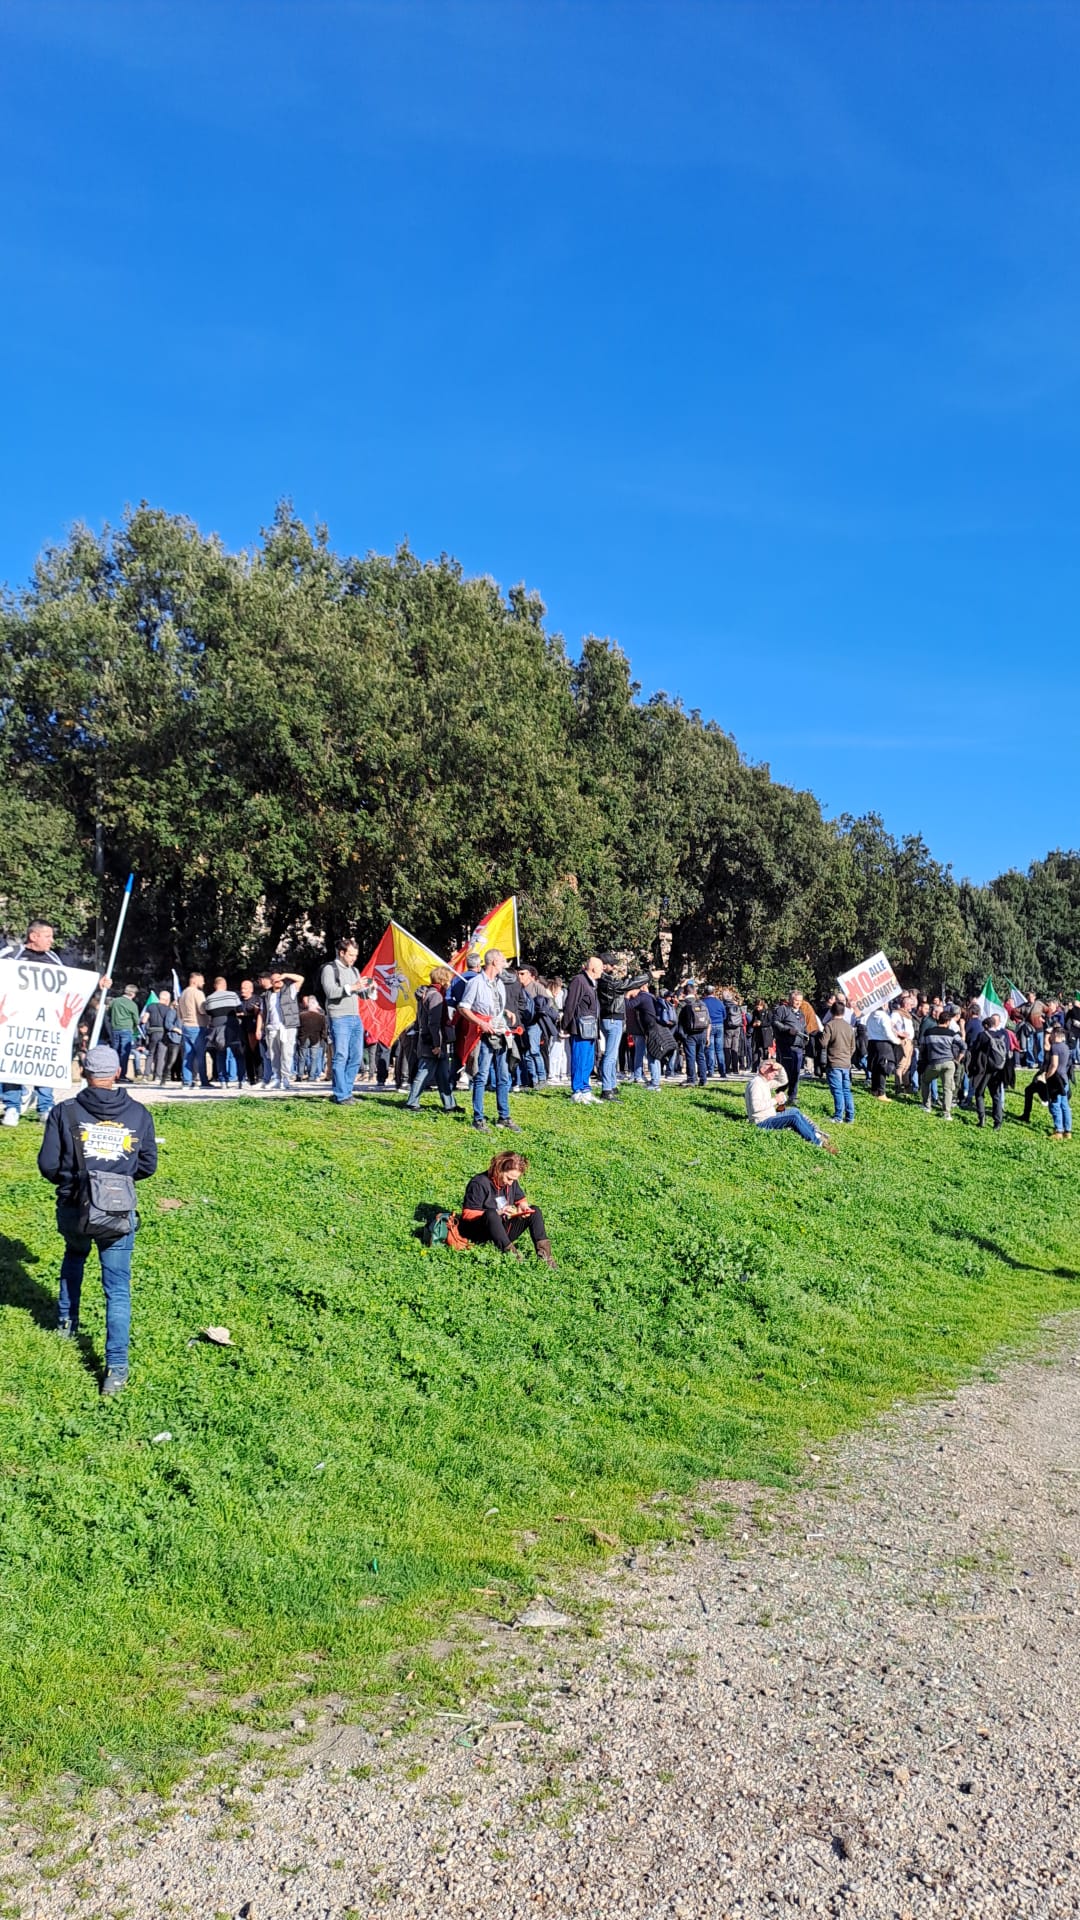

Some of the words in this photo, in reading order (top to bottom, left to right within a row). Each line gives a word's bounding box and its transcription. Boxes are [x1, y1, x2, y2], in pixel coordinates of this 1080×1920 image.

[869, 960, 887, 978] ALLE
[17, 965, 68, 994] STOP
[844, 970, 875, 1002] NO
[856, 980, 896, 1011] COLTIVATE
[35, 1007, 46, 1022] A
[6, 1025, 49, 1043] TUTTE
[50, 1031, 61, 1045] LE
[4, 1042, 59, 1062] GUERRE
[9, 1060, 68, 1079] MONDO!
